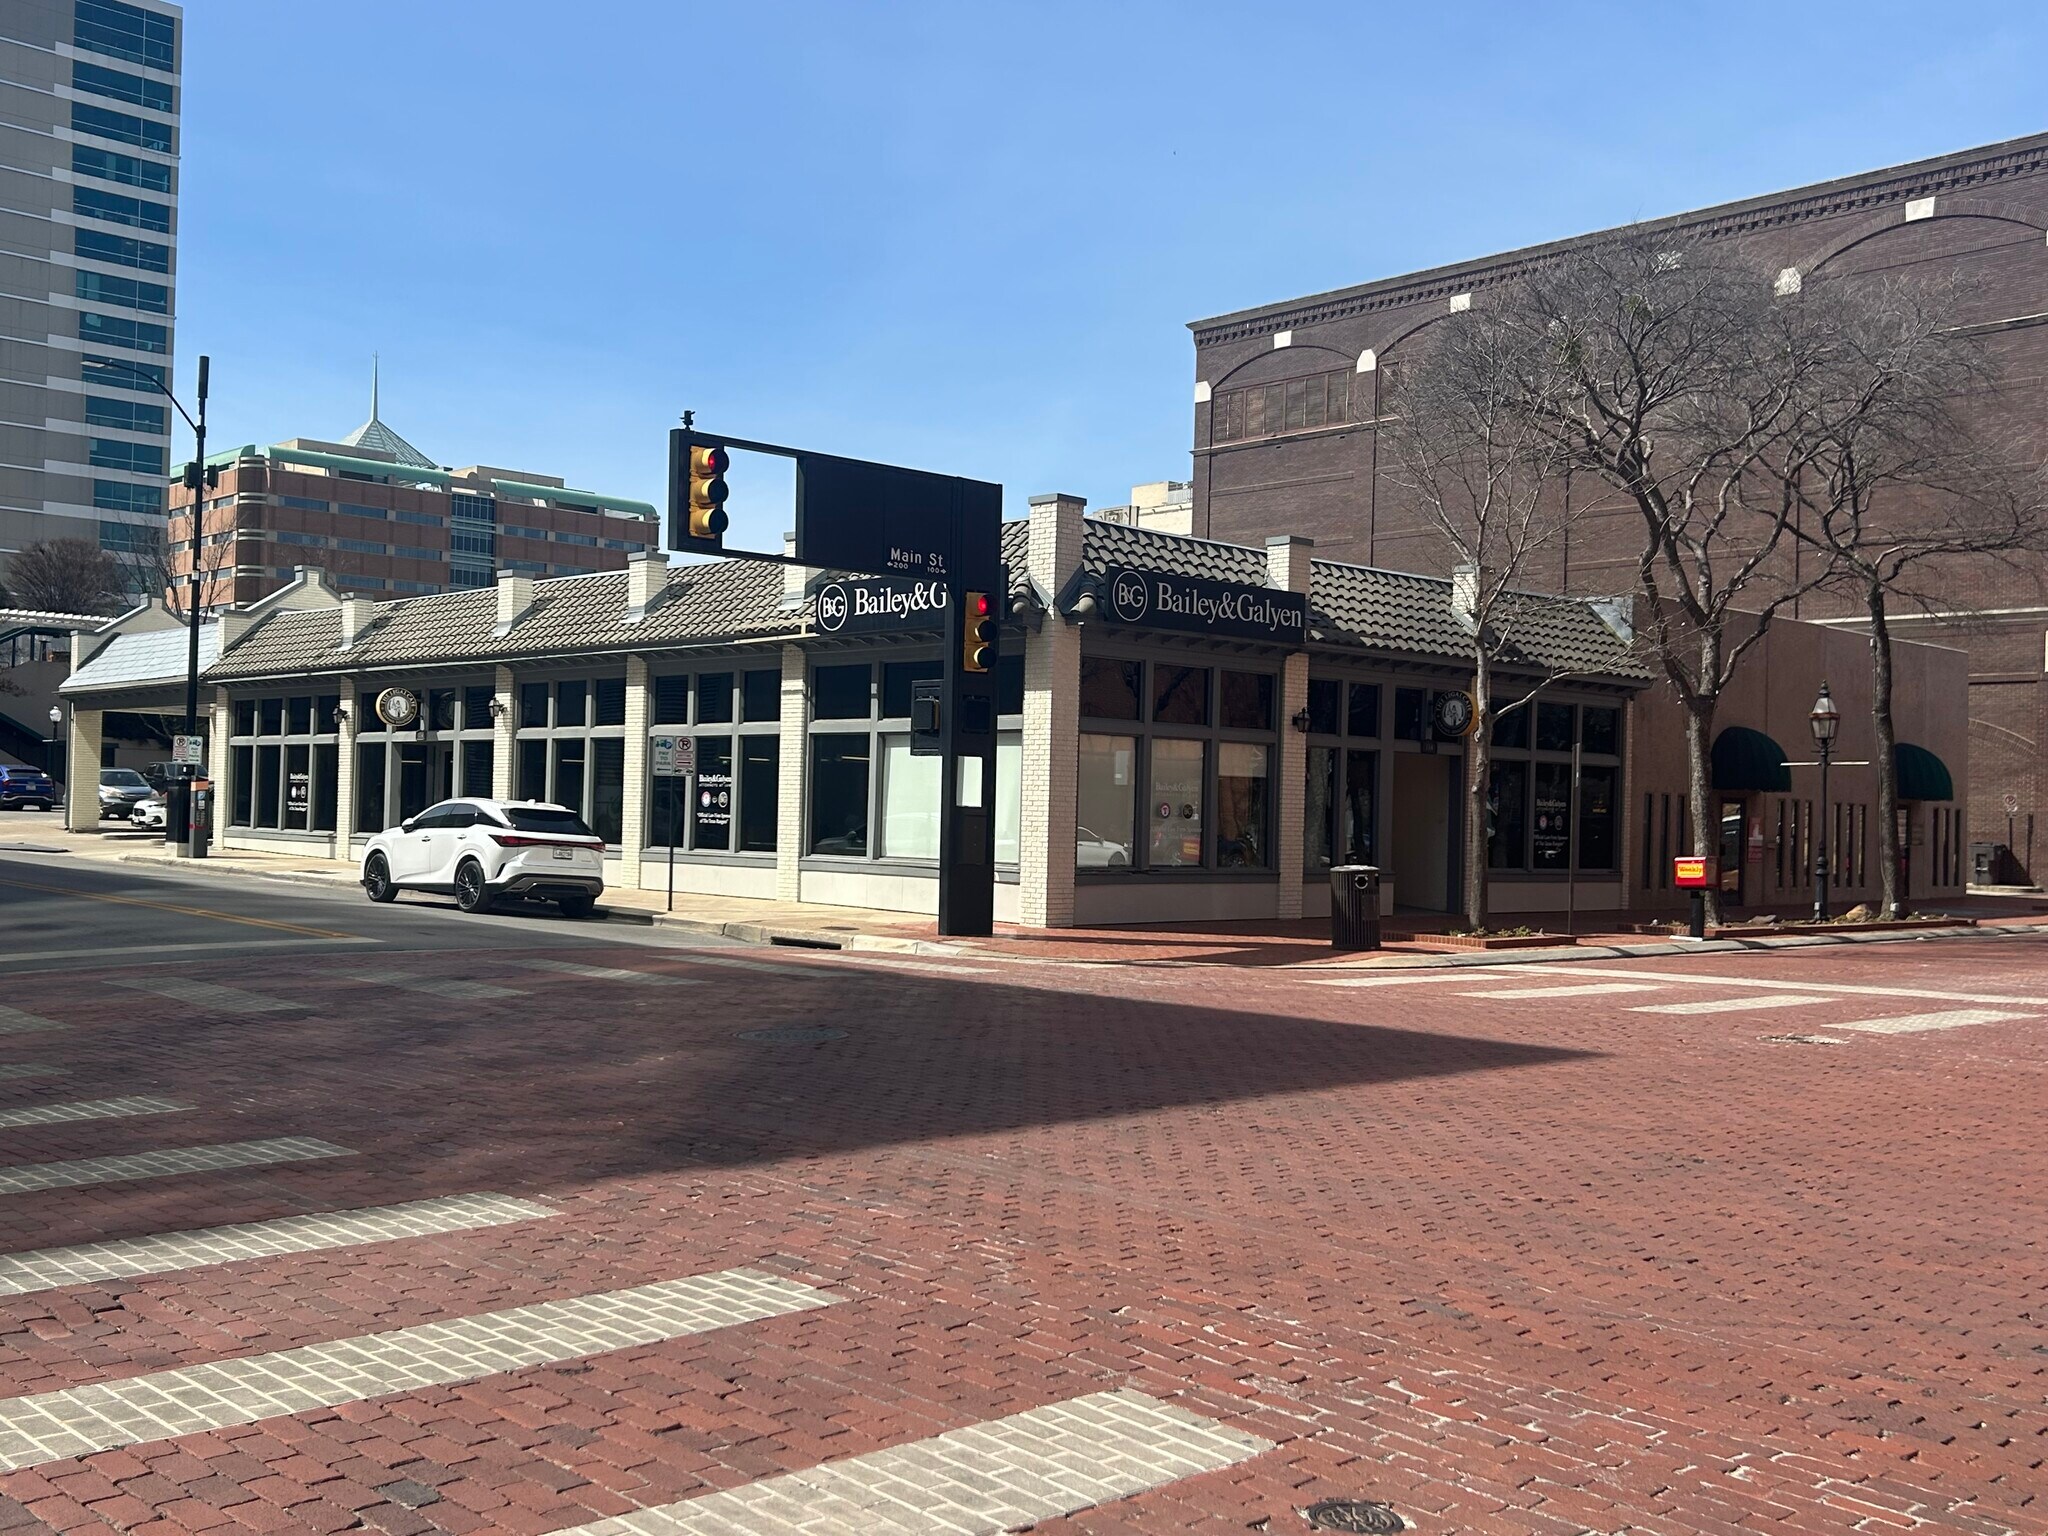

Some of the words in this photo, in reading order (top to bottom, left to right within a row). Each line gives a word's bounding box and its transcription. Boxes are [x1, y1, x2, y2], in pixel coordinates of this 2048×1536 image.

[890, 547, 922, 564] Main
[929, 553, 943, 567] St
[893, 562, 909, 570] 200
[927, 566, 940, 574] 100
[854, 581, 947, 619] Bailey&G
[1156, 581, 1302, 631] Bailey&Galyen
